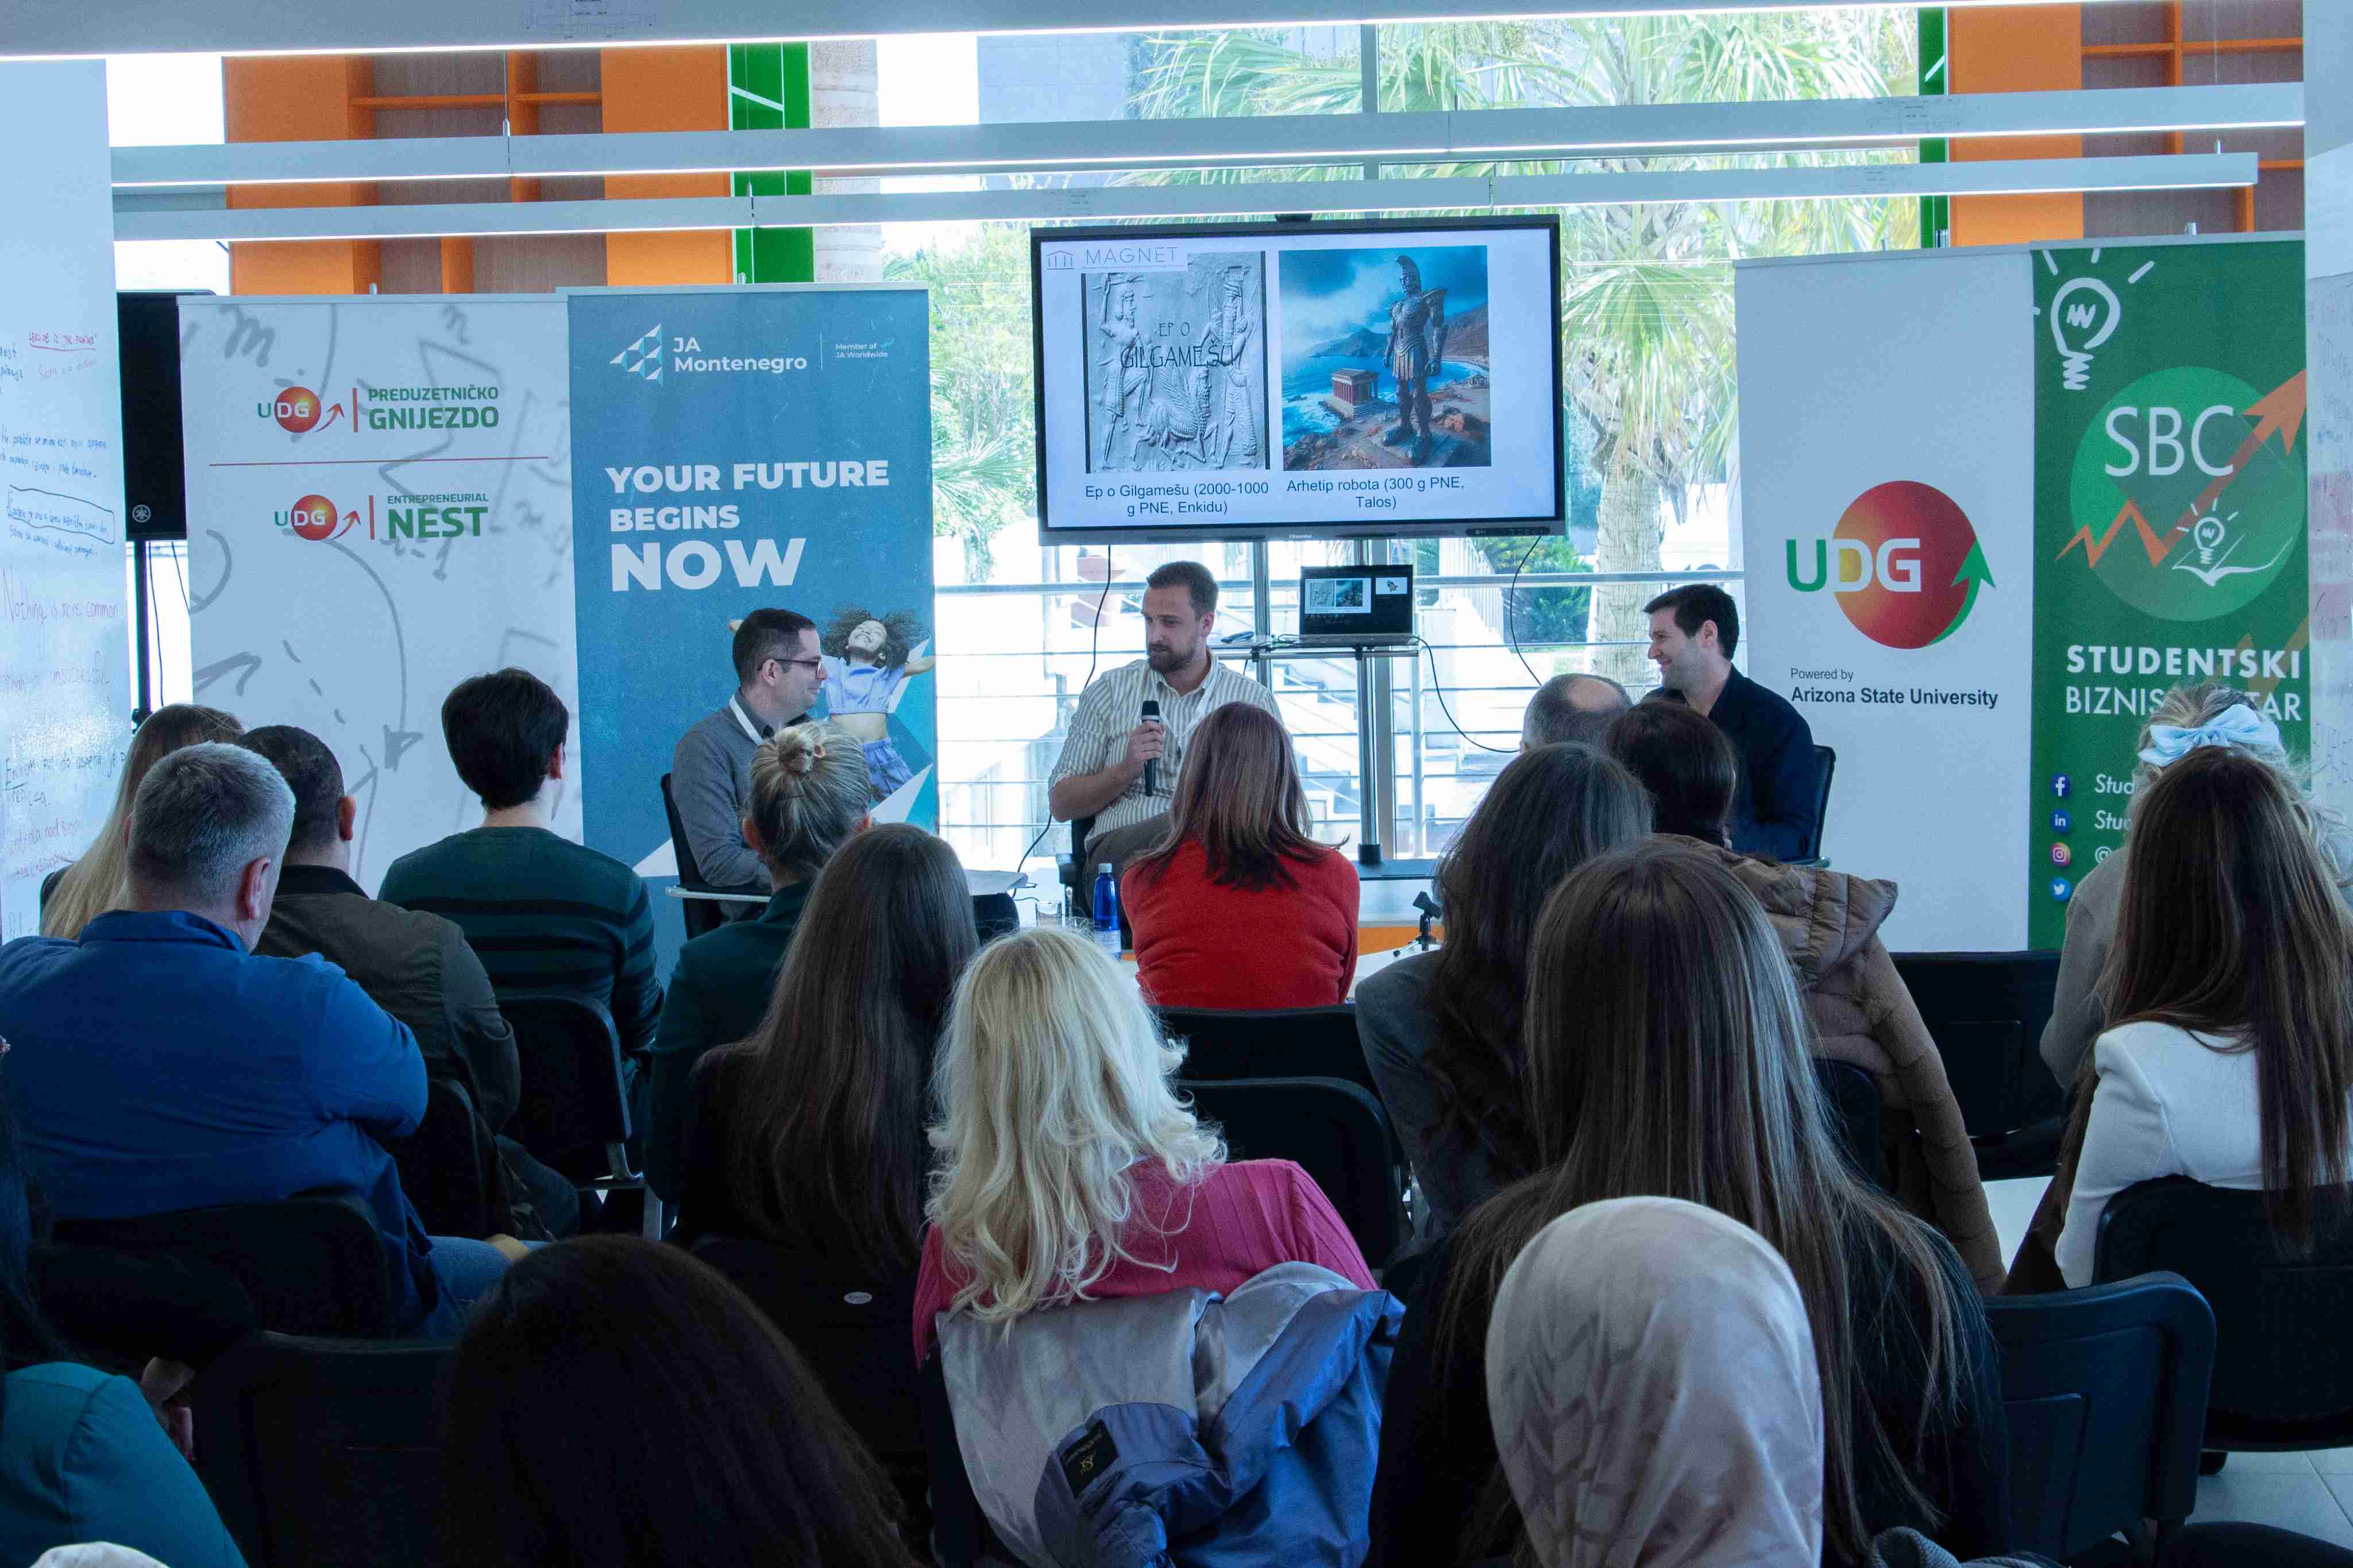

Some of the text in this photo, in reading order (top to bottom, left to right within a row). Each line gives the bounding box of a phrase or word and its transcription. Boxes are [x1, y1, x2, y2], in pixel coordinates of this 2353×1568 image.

[1086, 246, 1178, 264] MAGNET
[1159, 322, 1190, 337] EP O
[673, 337, 701, 353] JA
[674, 356, 807, 374] Montenegro
[368, 384, 499, 401] PREDUZETNIČKO
[257, 401, 310, 419] UDG
[369, 406, 499, 430] GNIJEZDO
[2105, 405, 2234, 477] SBC
[605, 460, 889, 493] YOUR FUTURE
[1287, 476, 1464, 494] Arhetip robota (300 g PNE,
[387, 493, 488, 504] ENTREPRENEURIAL
[1085, 482, 1268, 500] Ep o Gilgamešu (2000-1000
[1127, 500, 1228, 517] g PNE, Enkidu)
[1356, 496, 1397, 510] Talos)
[275, 510, 326, 527] UDG
[388, 507, 488, 539] NEST
[610, 505, 740, 532] BEGINS
[611, 538, 807, 592] NOW
[1786, 538, 1922, 593] UDG
[2066, 644, 2300, 679] STUDENTSKI
[1791, 668, 1854, 682] Powered by
[1791, 687, 1999, 709] Arizona State University
[2066, 686, 2164, 716] BIZNIS
